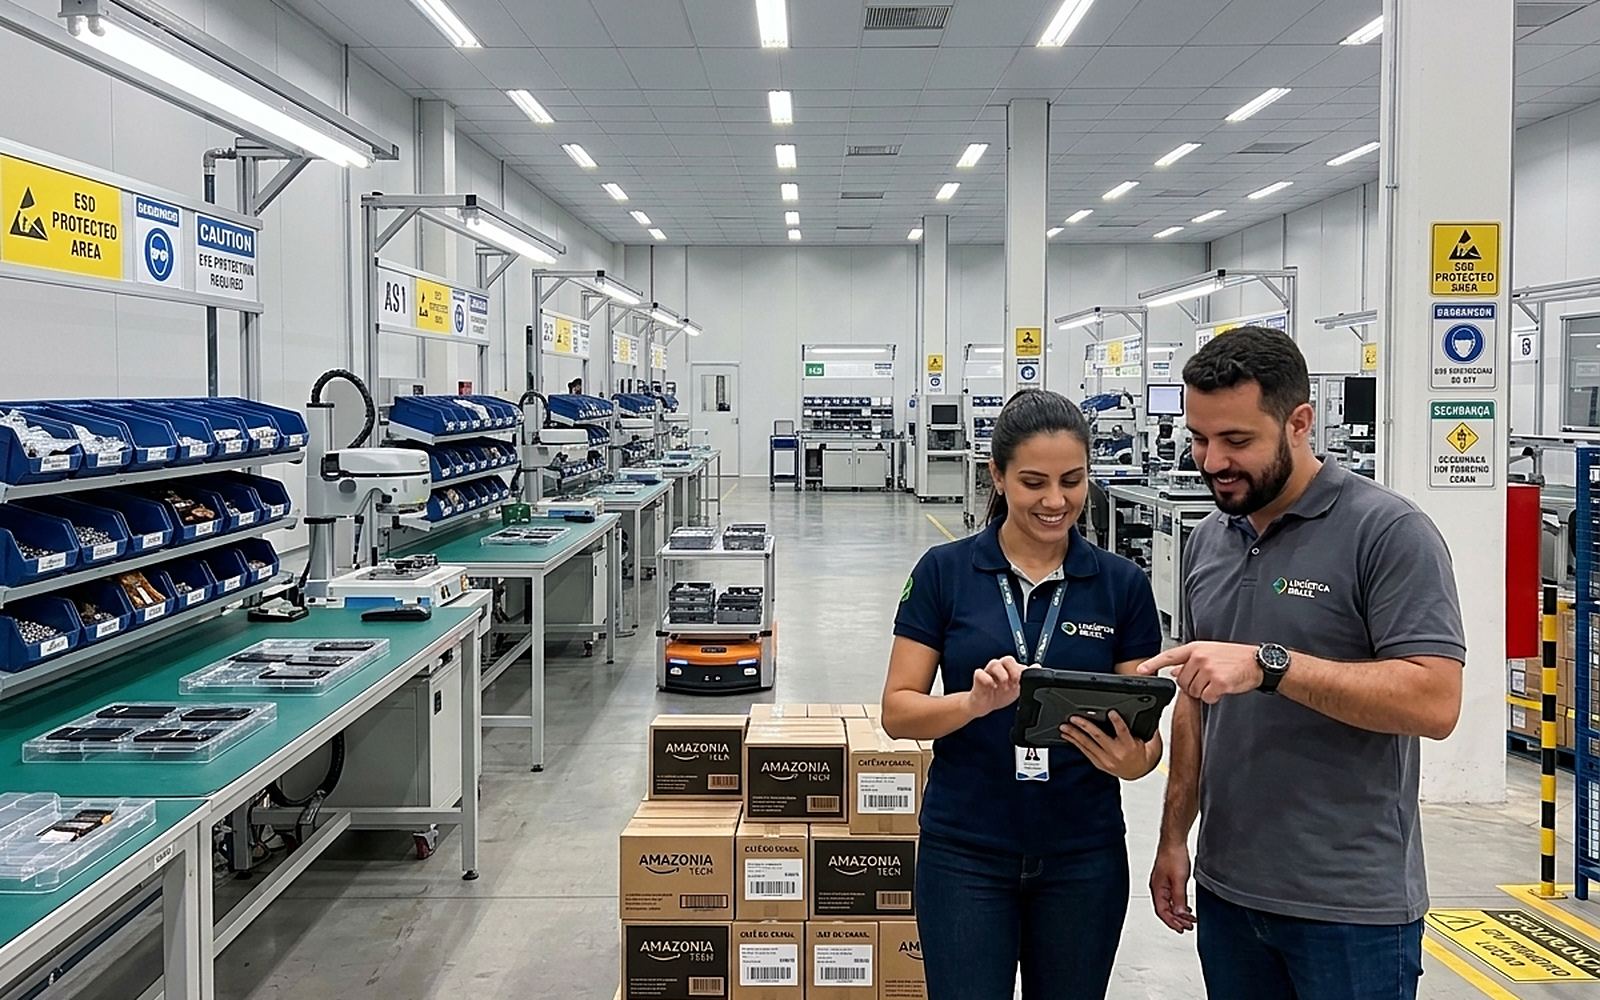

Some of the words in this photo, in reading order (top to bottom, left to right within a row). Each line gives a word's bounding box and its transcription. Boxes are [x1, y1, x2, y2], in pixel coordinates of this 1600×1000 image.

[52, 211, 117, 240] PROTECTED
[200, 223, 252, 252] CAUTION
[71, 239, 101, 260] AREA
[1435, 272, 1495, 282] PROTECTED
[665, 743, 730, 754] AMAZONIA
[760, 761, 831, 773] AMAZONIA
[638, 854, 713, 866] AMAZONIA
[828, 855, 901, 867] AMAZONIA
[689, 867, 714, 876] TECH
[640, 940, 714, 953] AMAZONIA
